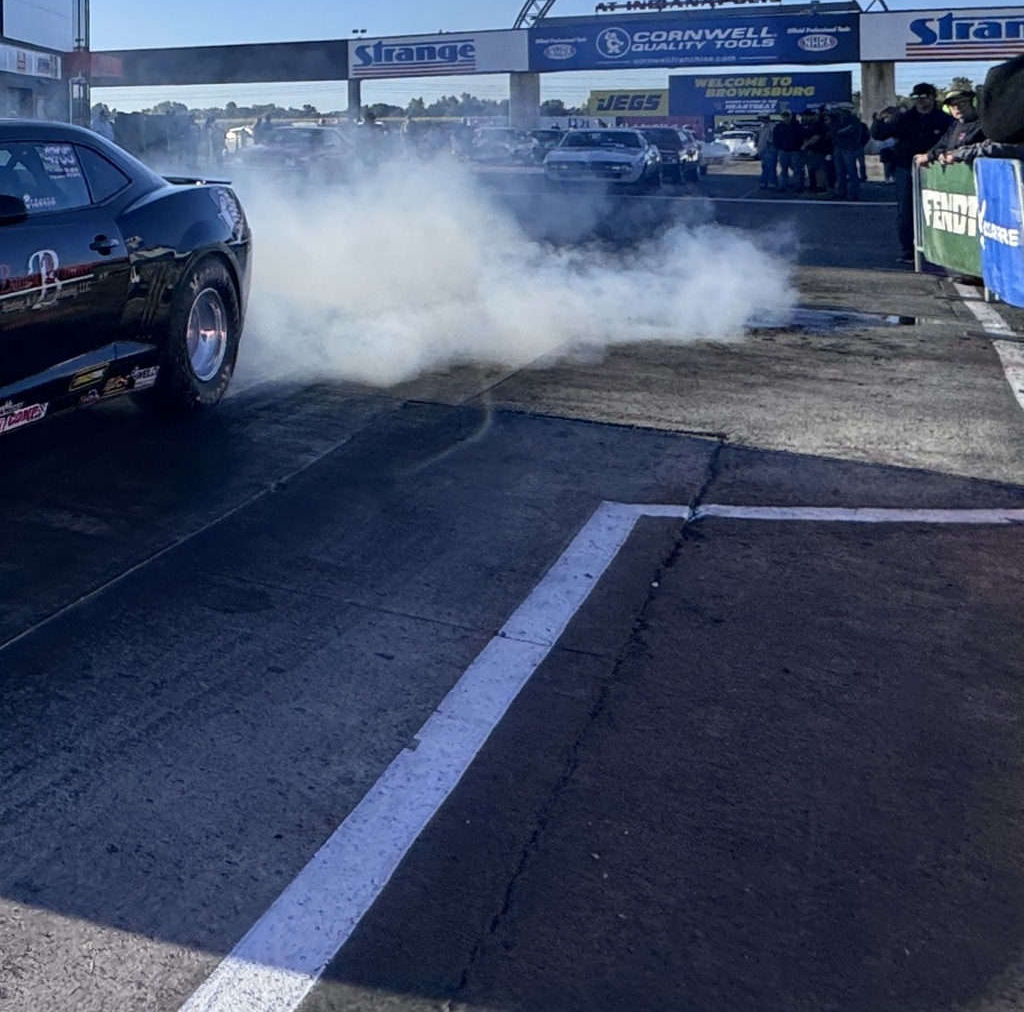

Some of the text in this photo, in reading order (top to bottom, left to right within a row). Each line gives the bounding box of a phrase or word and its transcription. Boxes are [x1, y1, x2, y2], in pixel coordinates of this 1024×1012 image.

[596, 1, 617, 12] AT
[632, 26, 774, 42] CORNWELL
[631, 38, 775, 52] QUALITY TOOLS
[804, 37, 833, 48] NHRA
[354, 40, 476, 67] Strange
[695, 76, 792, 88] WELCOME TO
[705, 86, 816, 98] BROWNSBURG
[596, 94, 661, 111] JEGS
